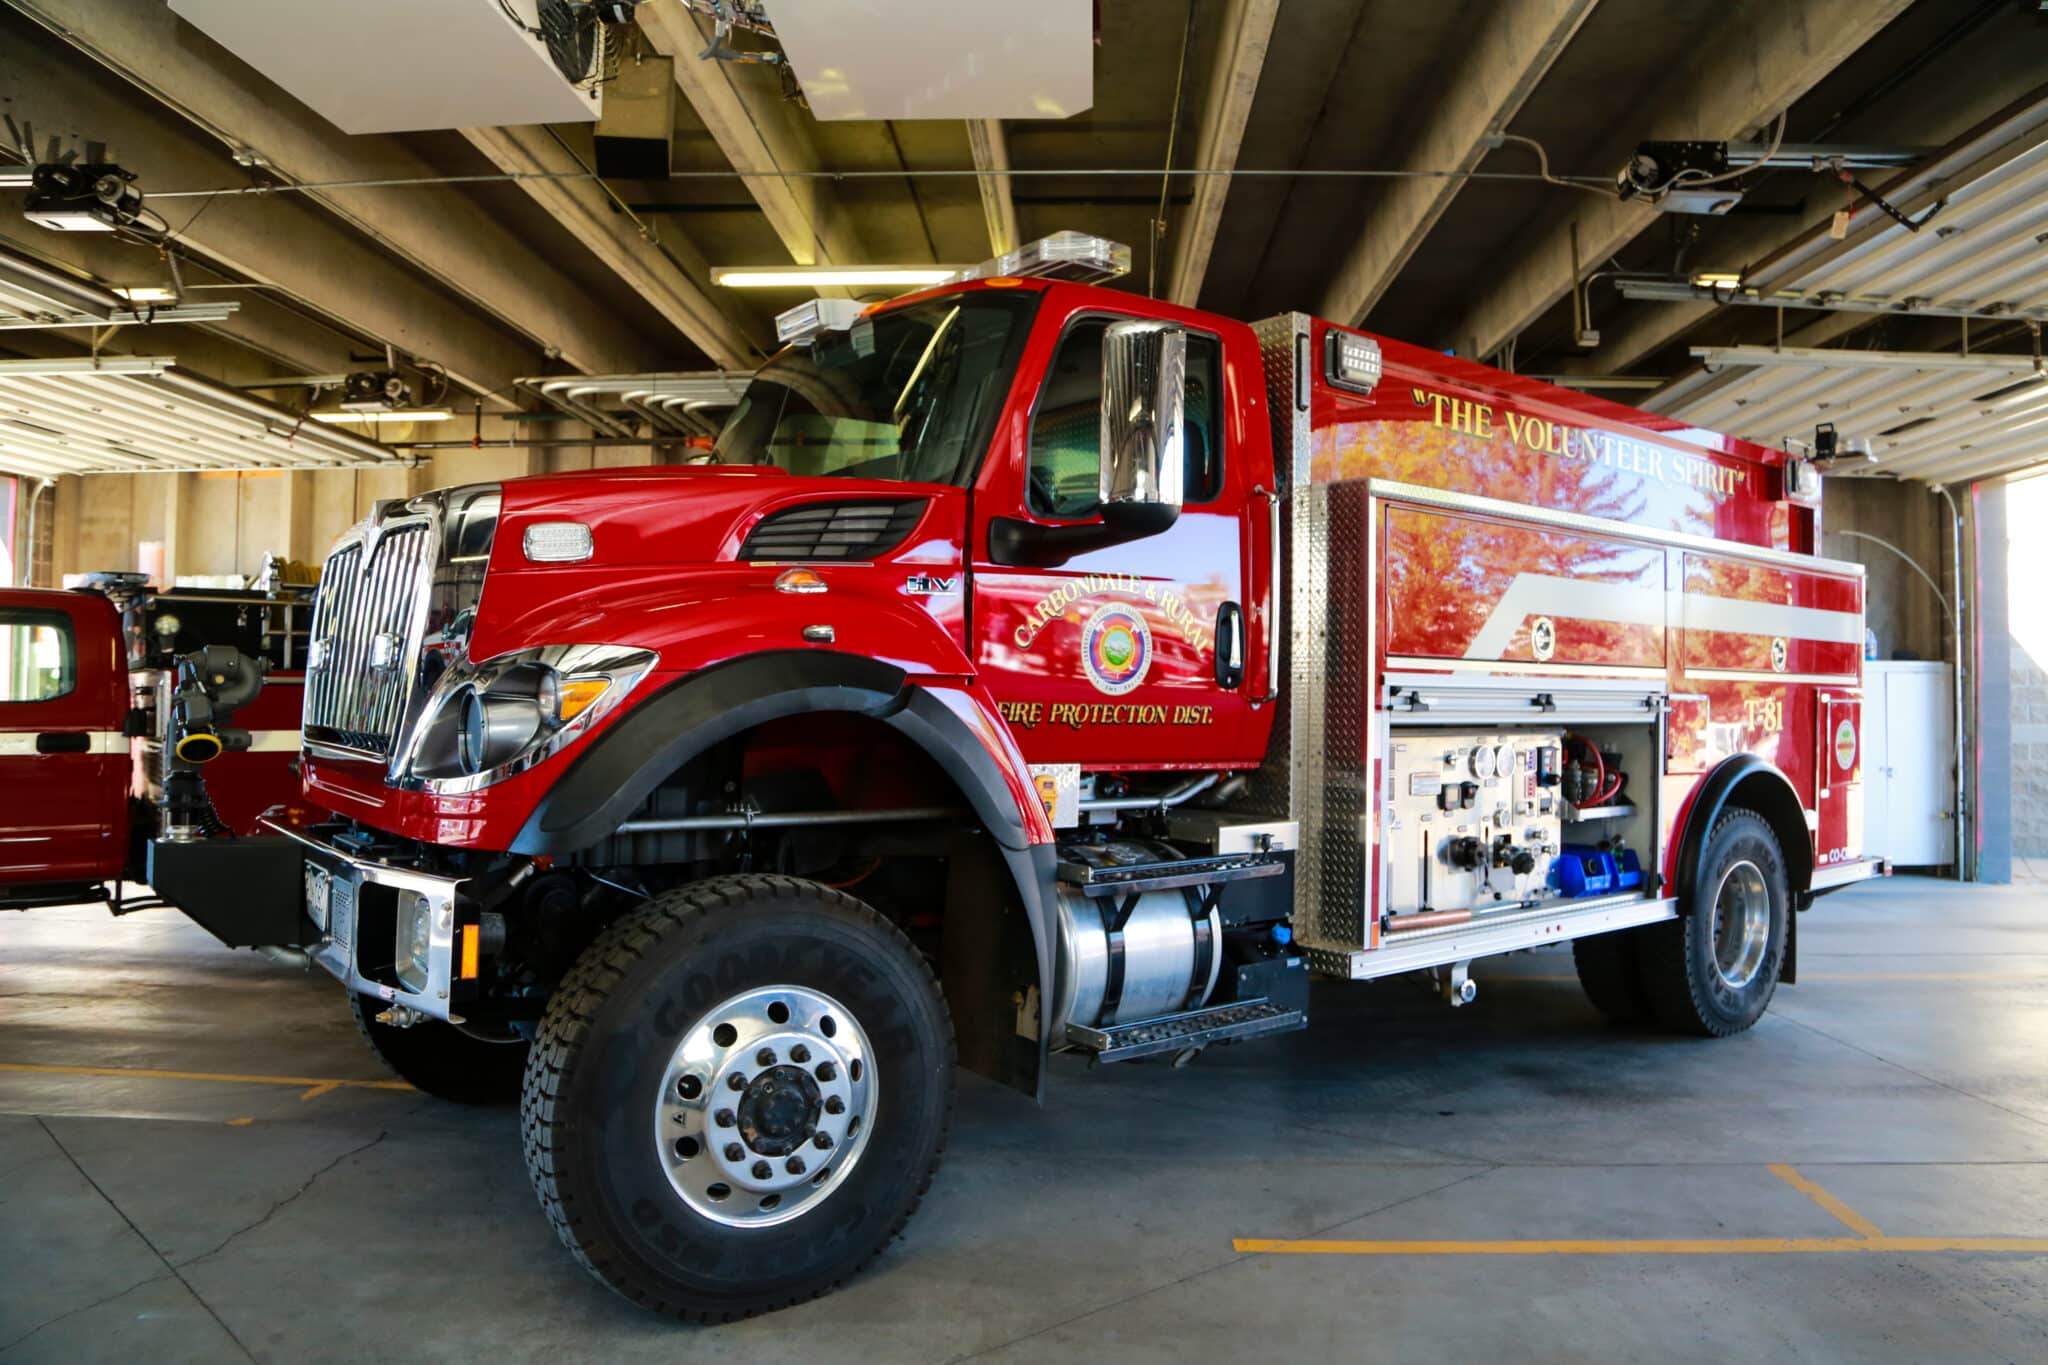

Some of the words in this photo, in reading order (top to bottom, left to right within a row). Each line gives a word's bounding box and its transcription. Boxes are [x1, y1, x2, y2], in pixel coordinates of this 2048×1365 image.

[1504, 411, 1667, 482] VOLUNTEER
[1013, 572, 1142, 649] CARBONDALE
[1144, 583, 1157, 602] &
[1160, 589, 1209, 658] RURAL
[997, 701, 1043, 729] FIRE
[1048, 702, 1168, 730] PROTECTION
[1172, 703, 1214, 726] DIST.
